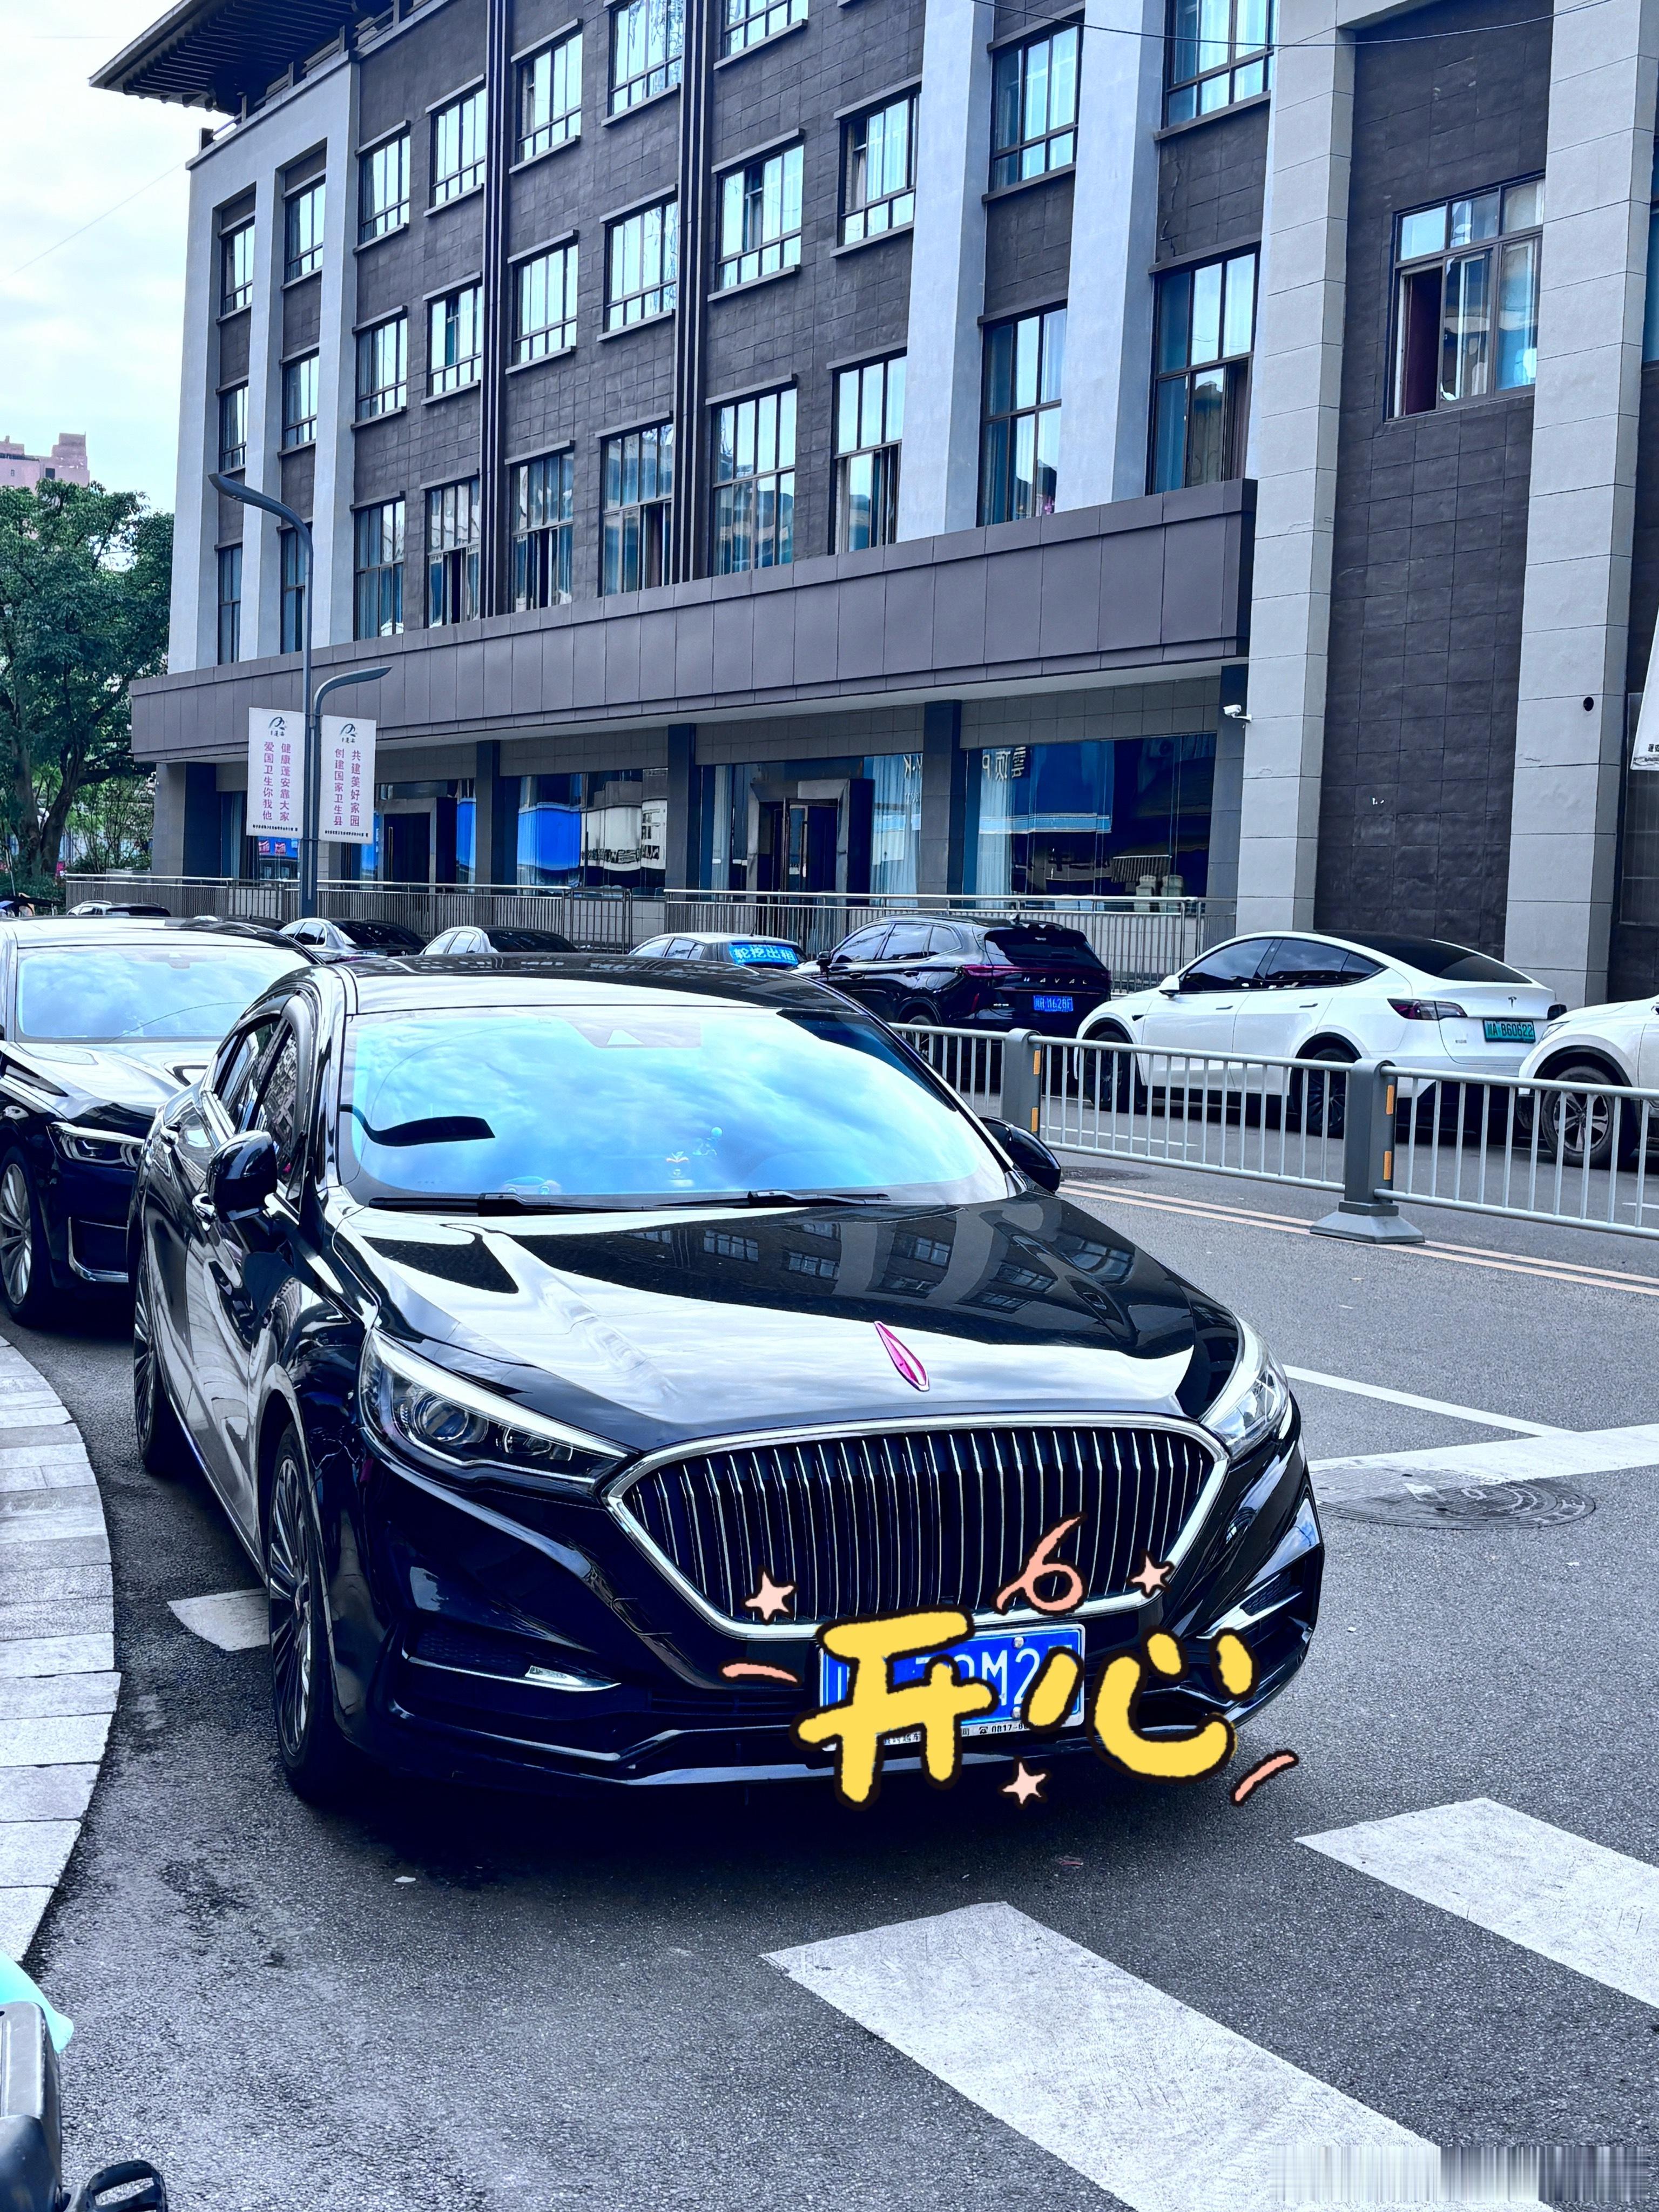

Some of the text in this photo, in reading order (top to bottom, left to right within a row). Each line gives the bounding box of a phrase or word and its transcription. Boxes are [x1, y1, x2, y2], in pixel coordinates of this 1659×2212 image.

[262, 741, 274, 820] 爱国卫生你我他
[333, 748, 345, 826] 创建国家卫生县
